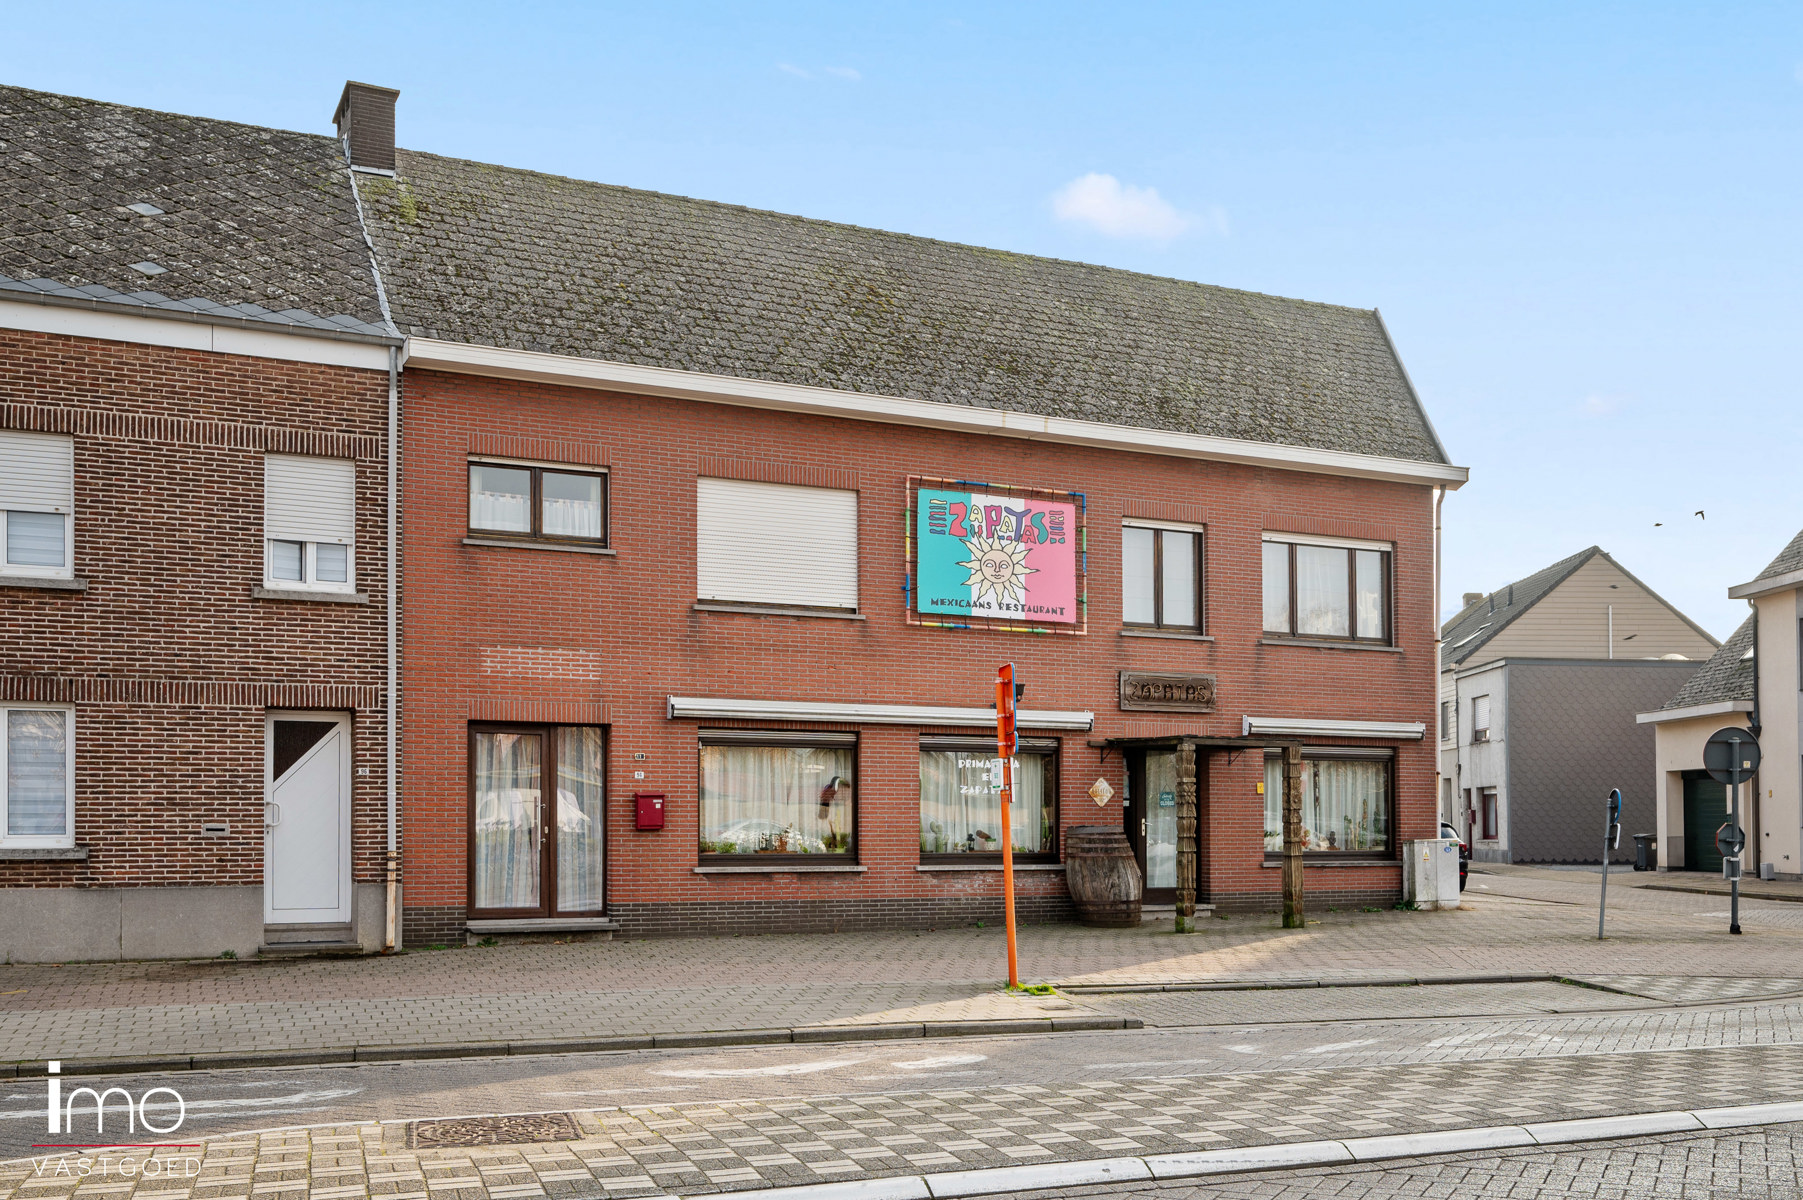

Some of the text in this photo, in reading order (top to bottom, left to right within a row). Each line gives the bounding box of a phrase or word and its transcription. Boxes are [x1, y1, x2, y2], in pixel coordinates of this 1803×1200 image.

[948, 501, 1048, 545] ZAPATAS
[930, 598, 1066, 616] MEXICAANS RESTAURANT
[1130, 681, 1207, 702] ZAPATAS
